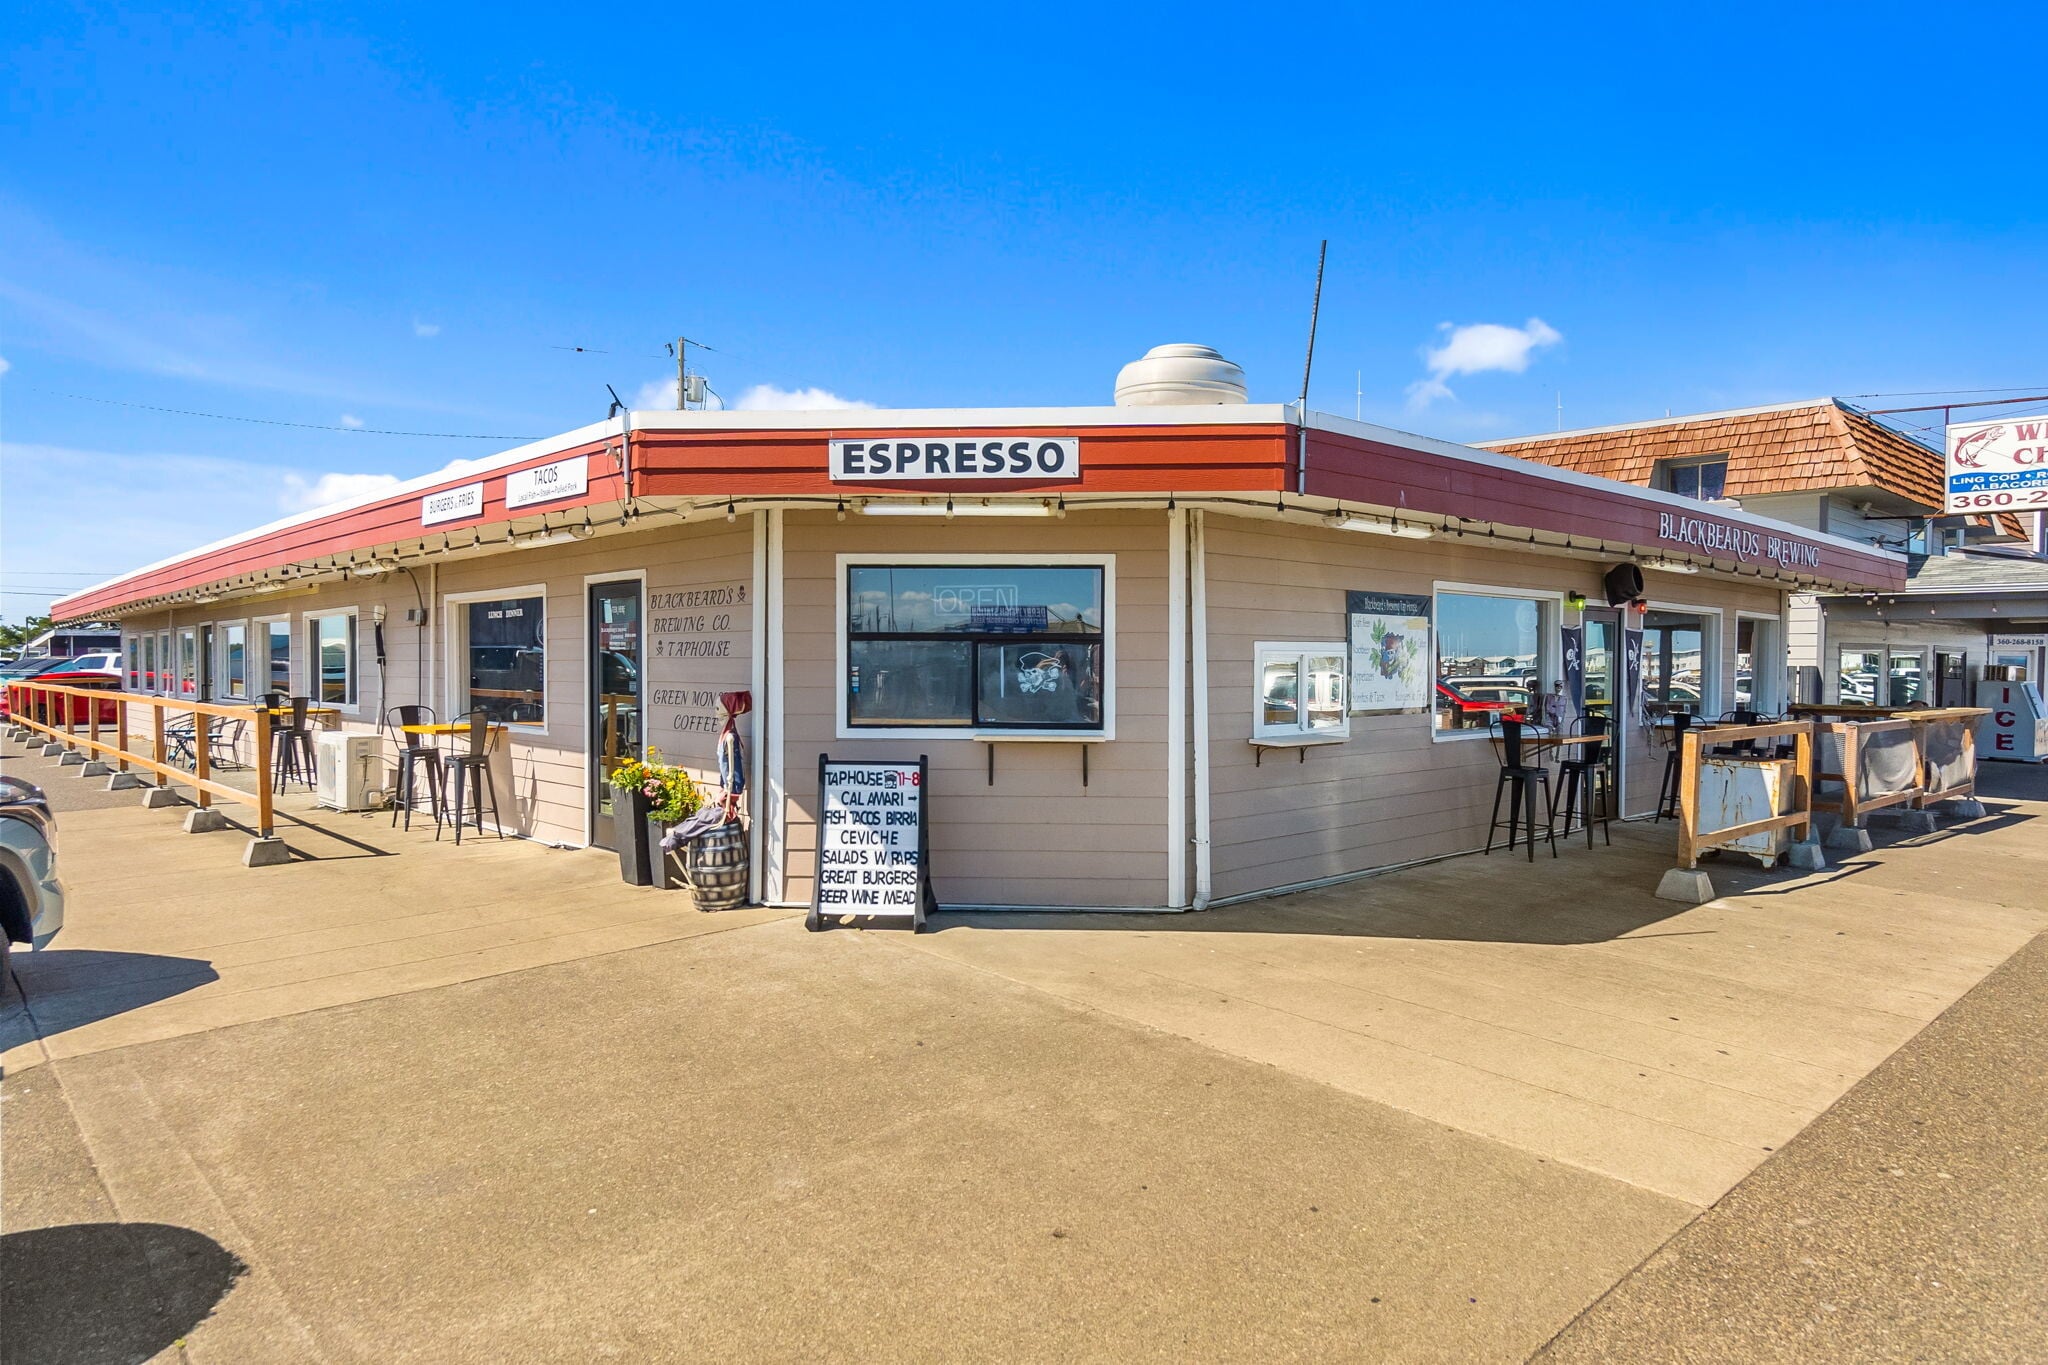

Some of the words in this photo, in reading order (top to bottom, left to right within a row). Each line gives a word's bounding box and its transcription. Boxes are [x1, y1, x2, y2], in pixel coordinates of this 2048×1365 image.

[843, 442, 1065, 474] ESPRESSO
[534, 466, 559, 486] TACOS
[1952, 476, 1985, 485] LING
[1989, 474, 2020, 482] COD
[1970, 480, 2048, 491] ALBACORE
[429, 496, 454, 514] BURGERS
[458, 490, 474, 508] FRIES
[1953, 490, 2048, 508] 360-2
[1659, 512, 1760, 563] BLACKBEARDS
[1767, 536, 1819, 569] BREWING
[650, 585, 734, 609] BLACKBEARD'S
[939, 588, 1013, 613] OPEN
[653, 615, 705, 633] BREWING
[712, 614, 731, 631] CO.
[668, 640, 731, 657] TAPHOUSE
[653, 689, 689, 705] GREEN
[673, 714, 719, 733] COFFEE
[1995, 688, 2016, 750] ICE
[825, 771, 883, 786] TAPHOUSE
[897, 771, 921, 787] 11-8
[841, 791, 904, 806] CALAMARI
[824, 810, 846, 825] FISH
[850, 810, 881, 826] TACOS
[886, 811, 917, 826] BIRRIA
[840, 830, 898, 845] CEVICHE
[822, 850, 868, 865] SALADS
[874, 850, 918, 866] WRAPS
[821, 870, 858, 884] GREAT
[863, 870, 916, 885] BURGERS
[820, 890, 848, 904] BEER
[852, 890, 879, 905] WINE
[884, 890, 916, 905] MEAD
